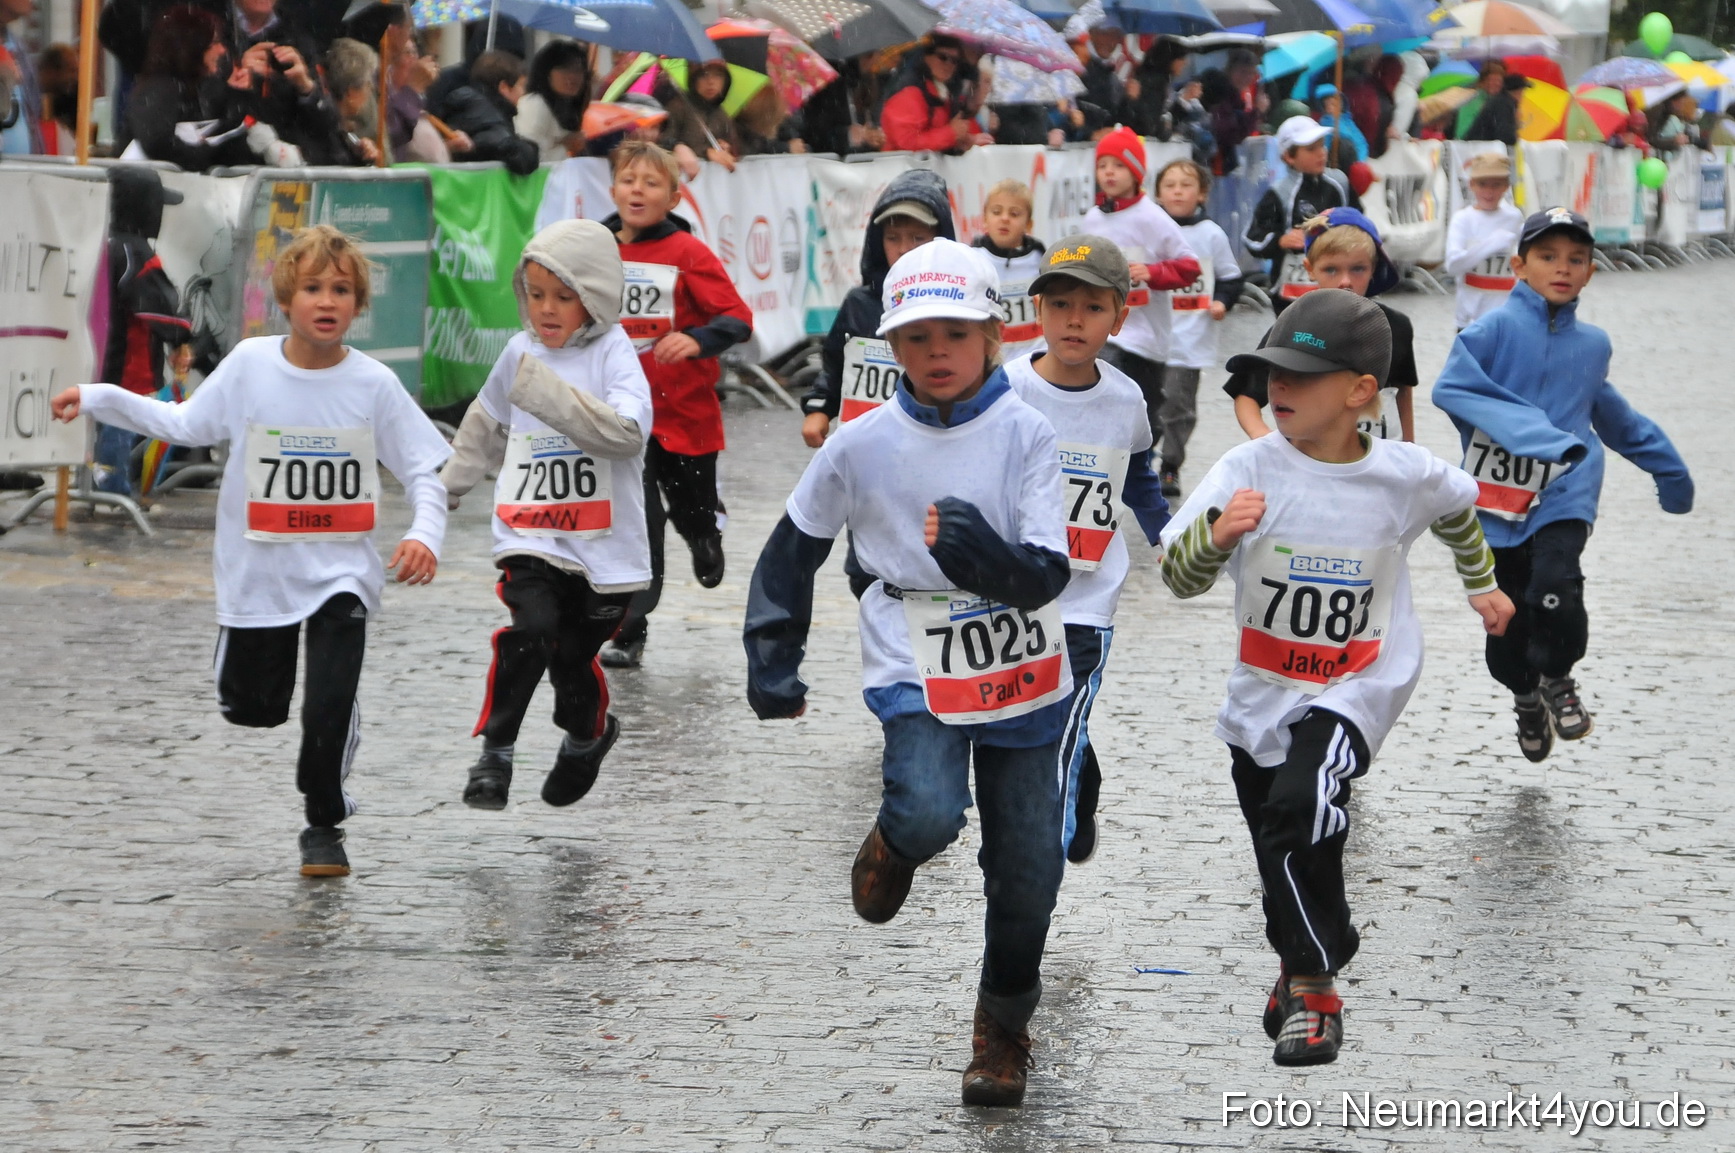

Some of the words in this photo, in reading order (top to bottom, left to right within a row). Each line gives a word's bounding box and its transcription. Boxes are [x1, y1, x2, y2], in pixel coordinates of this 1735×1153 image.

[907, 286, 965, 300] Slovenija
[919, 272, 967, 286] MRAVLJE
[619, 286, 661, 315] 82
[279, 435, 336, 449] BOCK
[531, 436, 568, 451] BOCK
[1059, 450, 1098, 468] OCK
[1473, 442, 1552, 490] 7301
[259, 457, 361, 501] 7000
[515, 457, 597, 501] 7206
[1068, 477, 1113, 527] 73
[287, 510, 333, 528] Elias
[1289, 555, 1363, 576] BOCK
[1261, 576, 1375, 644] 7083
[925, 608, 1042, 674] 7025
[1281, 649, 1336, 678] Jako
[979, 673, 1022, 705] Paul
